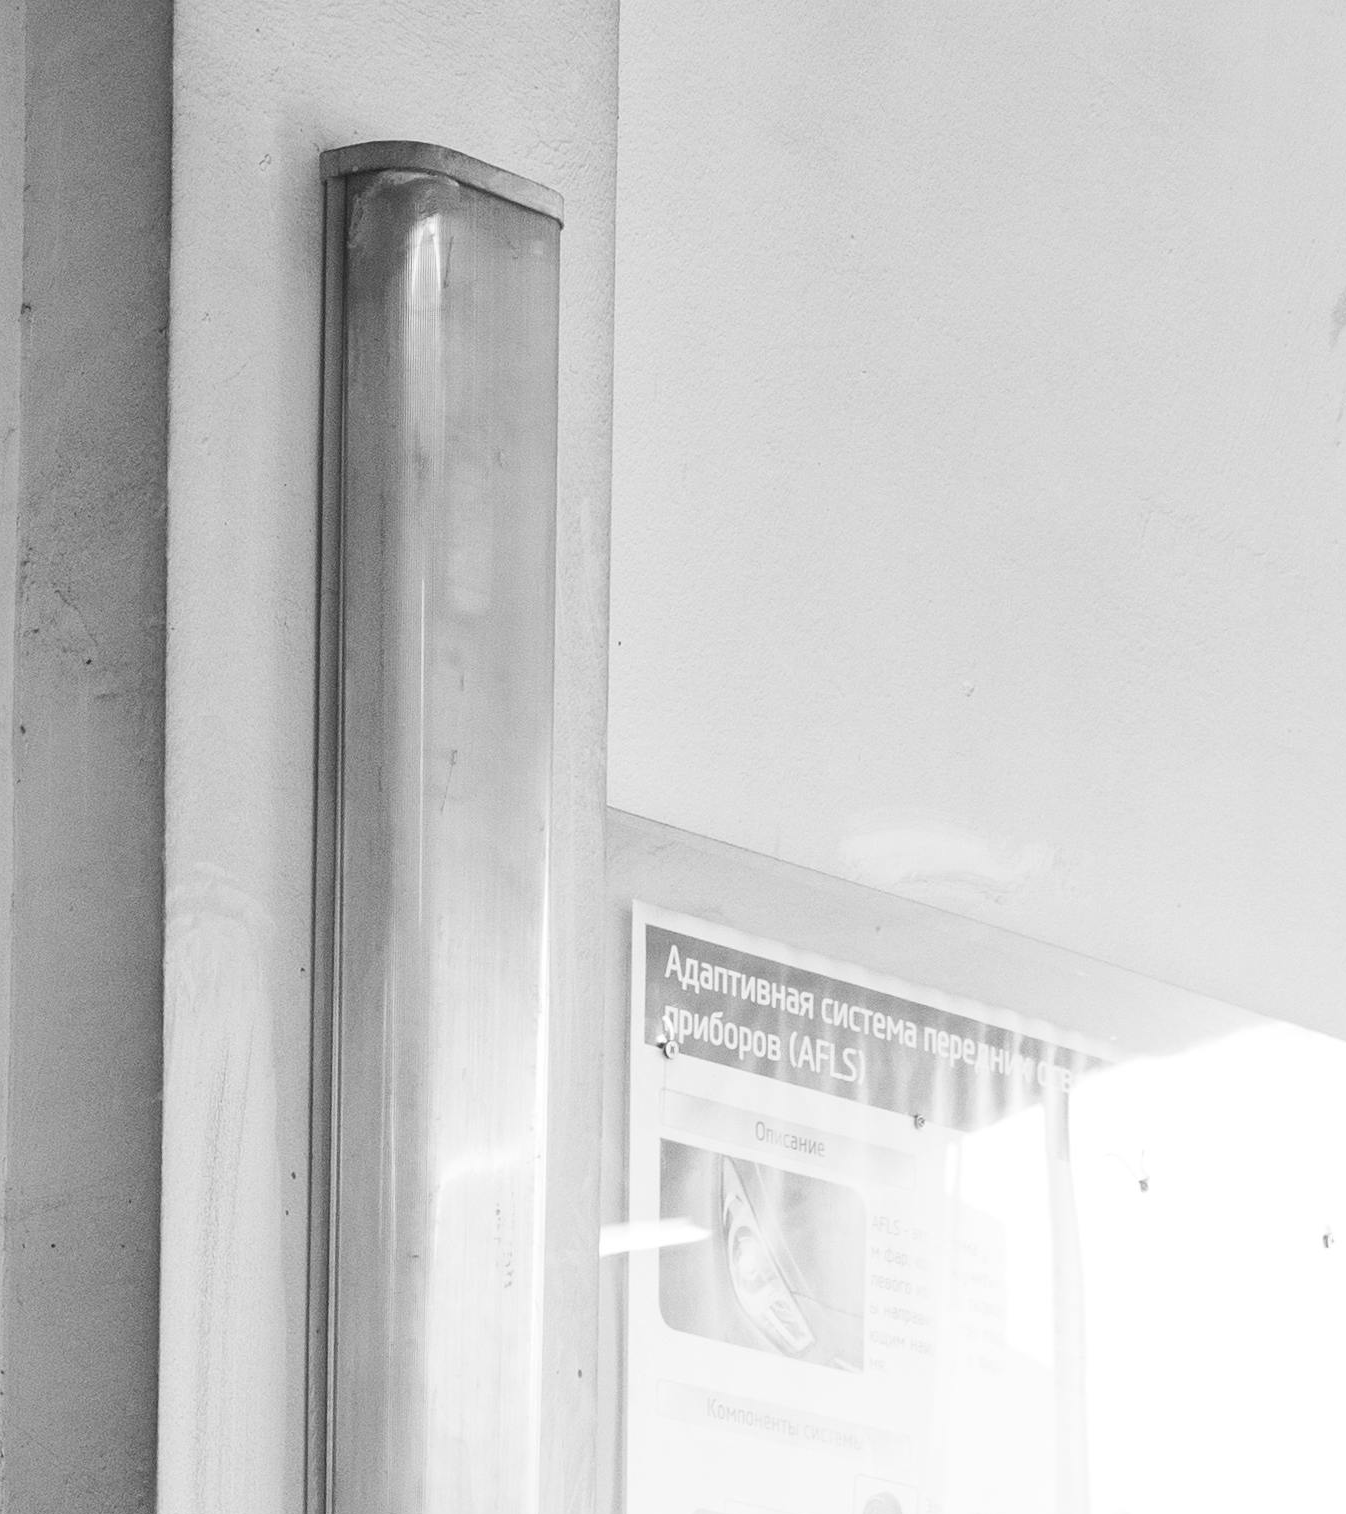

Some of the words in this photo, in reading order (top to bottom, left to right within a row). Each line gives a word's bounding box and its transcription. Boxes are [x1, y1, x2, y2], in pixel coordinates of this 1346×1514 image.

[663, 943, 815, 1021] Адаптивная
[821, 997, 918, 1050] система
[663, 1004, 782, 1062] приборов
[787, 1030, 865, 1085] (AFLS)
[754, 1119, 827, 1159] Описание
[706, 1396, 799, 1437] Компоненты
[803, 1423, 863, 1452] системы
